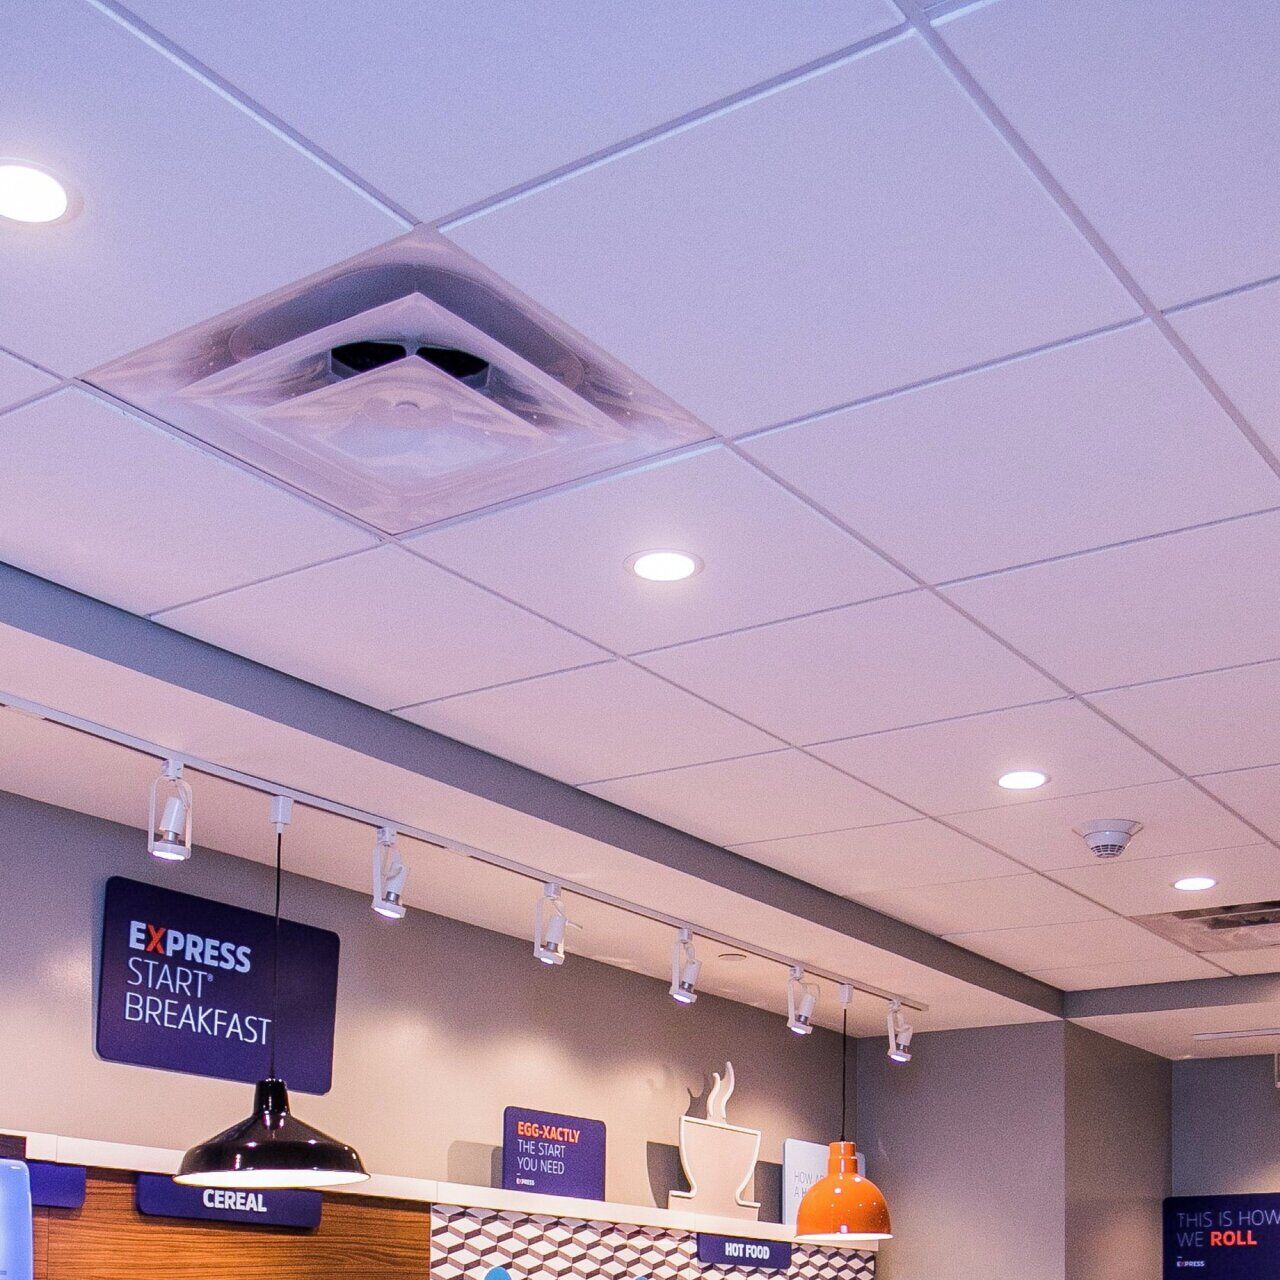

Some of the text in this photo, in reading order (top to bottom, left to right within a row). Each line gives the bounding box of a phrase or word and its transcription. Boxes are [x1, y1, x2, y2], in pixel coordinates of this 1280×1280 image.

[129, 920, 252, 973] EXPRESS
[124, 991, 272, 1045] BREAKFAST
[517, 1121, 580, 1143] EGG-XACTLY
[517, 1139, 566, 1158] THE START
[517, 1156, 565, 1174] YOU NEED
[203, 1189, 267, 1212] CEREAL
[1177, 1211, 1213, 1227] THIS
[1219, 1210, 1233, 1227] IS
[1177, 1230, 1258, 1247] WE ROLL
[725, 1242, 770, 1260] HOT FOOD
